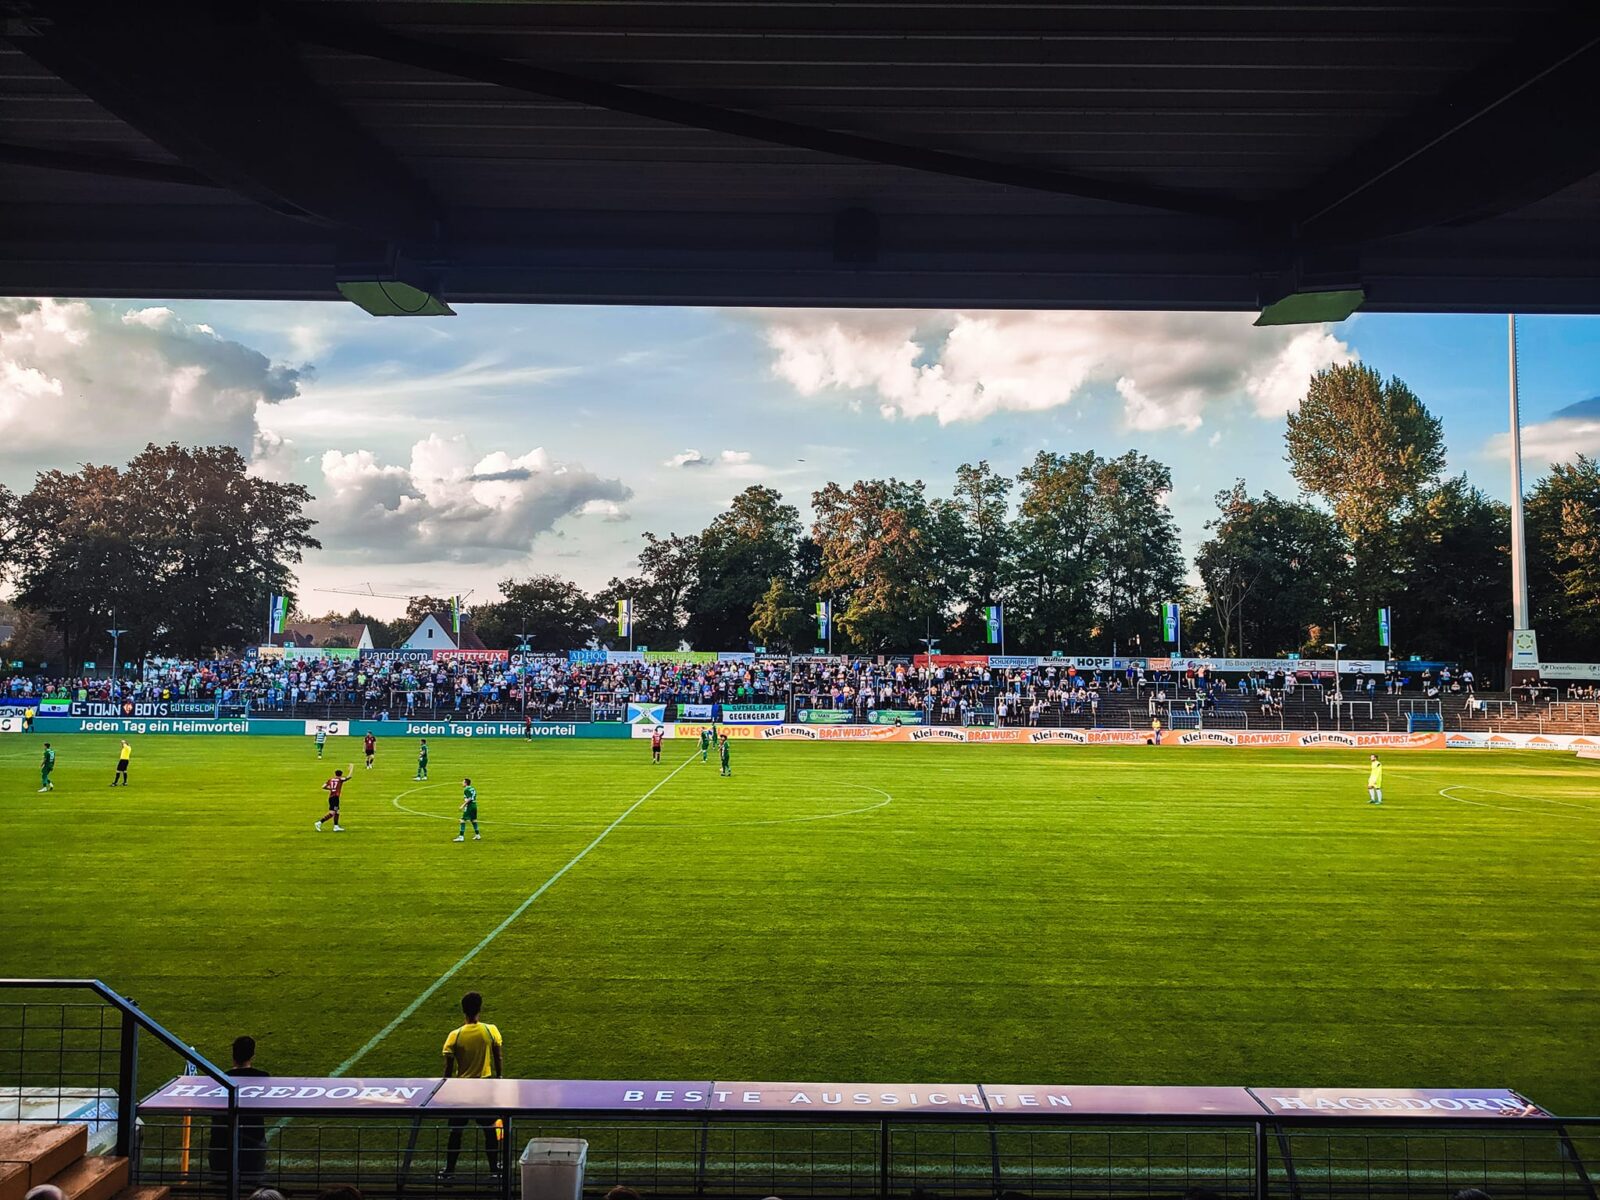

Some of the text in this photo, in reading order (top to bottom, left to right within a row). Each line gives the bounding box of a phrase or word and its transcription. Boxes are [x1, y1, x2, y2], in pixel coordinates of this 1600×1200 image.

[1077, 657, 1110, 667] HOPF
[71, 702, 168, 716] G-TOWN BOYS
[729, 712, 780, 720] GEGENGERADE
[80, 720, 249, 733] Jeden Tag ein Heimvorteil
[406, 724, 445, 735] Jeden
[448, 724, 473, 737] Tag
[475, 724, 496, 735] ein
[764, 726, 1409, 746] Kleinemas BRATWURST Kleinemas BRATWURST Kleinemas BRATWURST Kleinemas BRATWURST Kleinemas BRATWURST
[162, 1085, 424, 1099] HAGEDORN
[623, 1090, 1072, 1107] BESTE AUSSICHTEN
[1271, 1097, 1523, 1111] HAGEDORN
